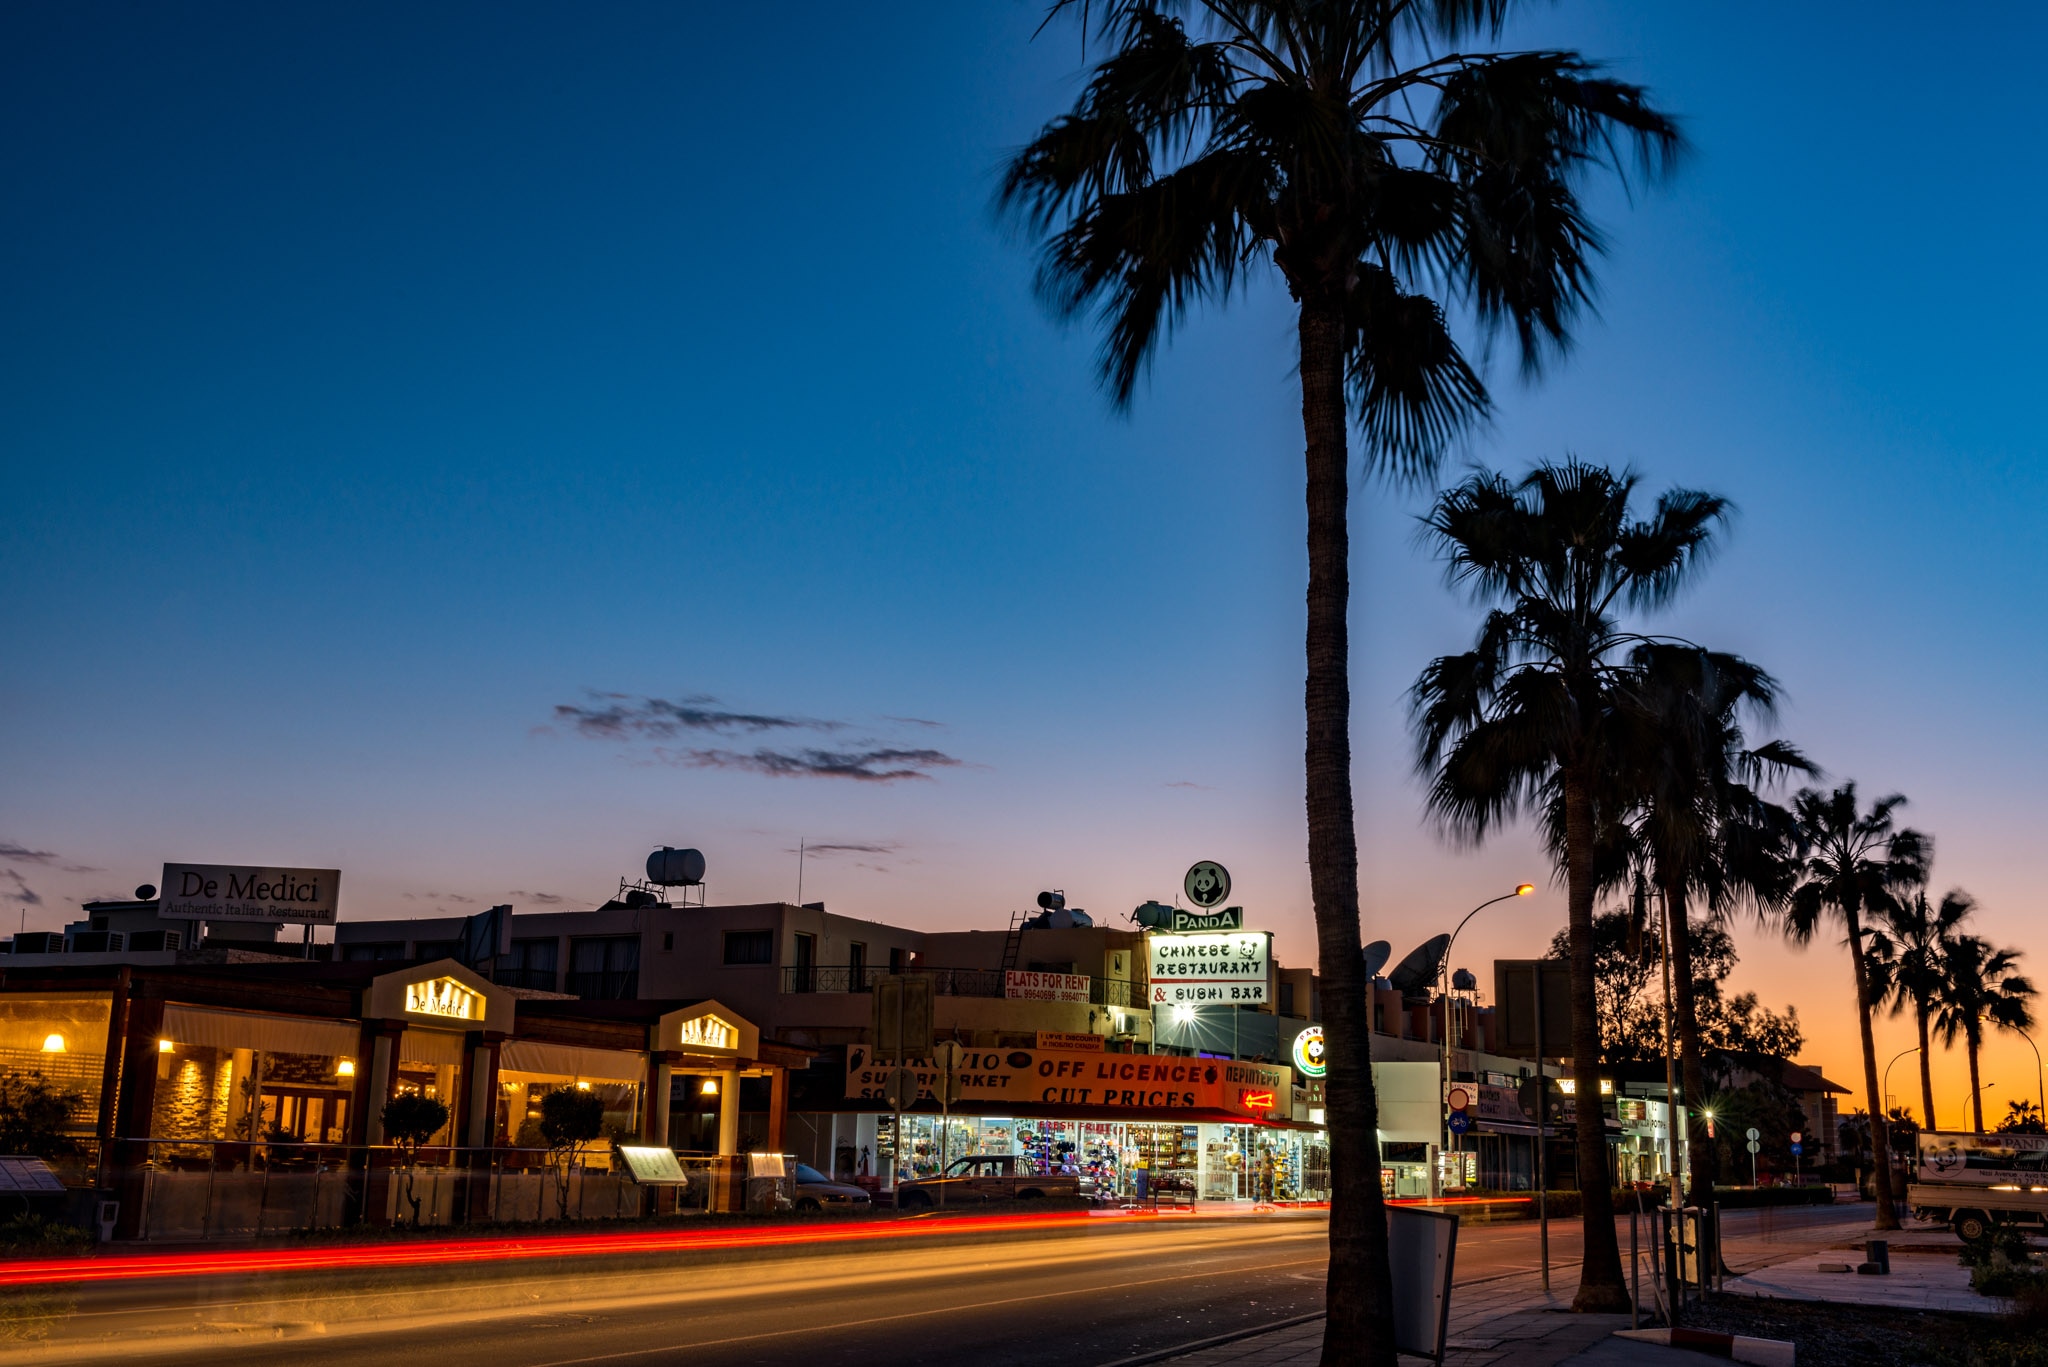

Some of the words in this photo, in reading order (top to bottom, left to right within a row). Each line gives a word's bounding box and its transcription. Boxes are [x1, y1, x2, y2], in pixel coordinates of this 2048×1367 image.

[179, 872, 218, 898] De
[225, 873, 319, 902] Medici
[164, 902, 222, 916] Authentic
[224, 904, 264, 916] Italian
[268, 905, 330, 919] Restaurant
[1175, 912, 1235, 930] PANDA
[1160, 944, 1230, 958] CHINESE
[1156, 961, 1261, 976] RESTAURANT
[1006, 972, 1039, 988] FLATS
[1042, 974, 1062, 990] FOR
[1065, 976, 1090, 990] RENT
[1006, 988, 1022, 998] TEL.
[1024, 989, 1056, 1000] 99640696
[1061, 992, 1088, 1002] 99640776
[1154, 987, 1167, 1002] &
[1176, 988, 1223, 1000] SUSHI
[1230, 986, 1262, 1000] BAR
[412, 996, 426, 1011] De
[430, 998, 464, 1017] Medici
[1066, 1034, 1101, 1042] DISCOUNTS
[861, 1071, 1010, 1088] SURRKET
[1038, 1060, 1085, 1078] OFF
[1096, 1062, 1202, 1082] LICENCE
[1042, 1087, 1092, 1104] CUT
[1104, 1090, 1195, 1107] PRICES
[1038, 1120, 1074, 1130] FRESH
[2006, 1138, 2048, 1151] PAND
